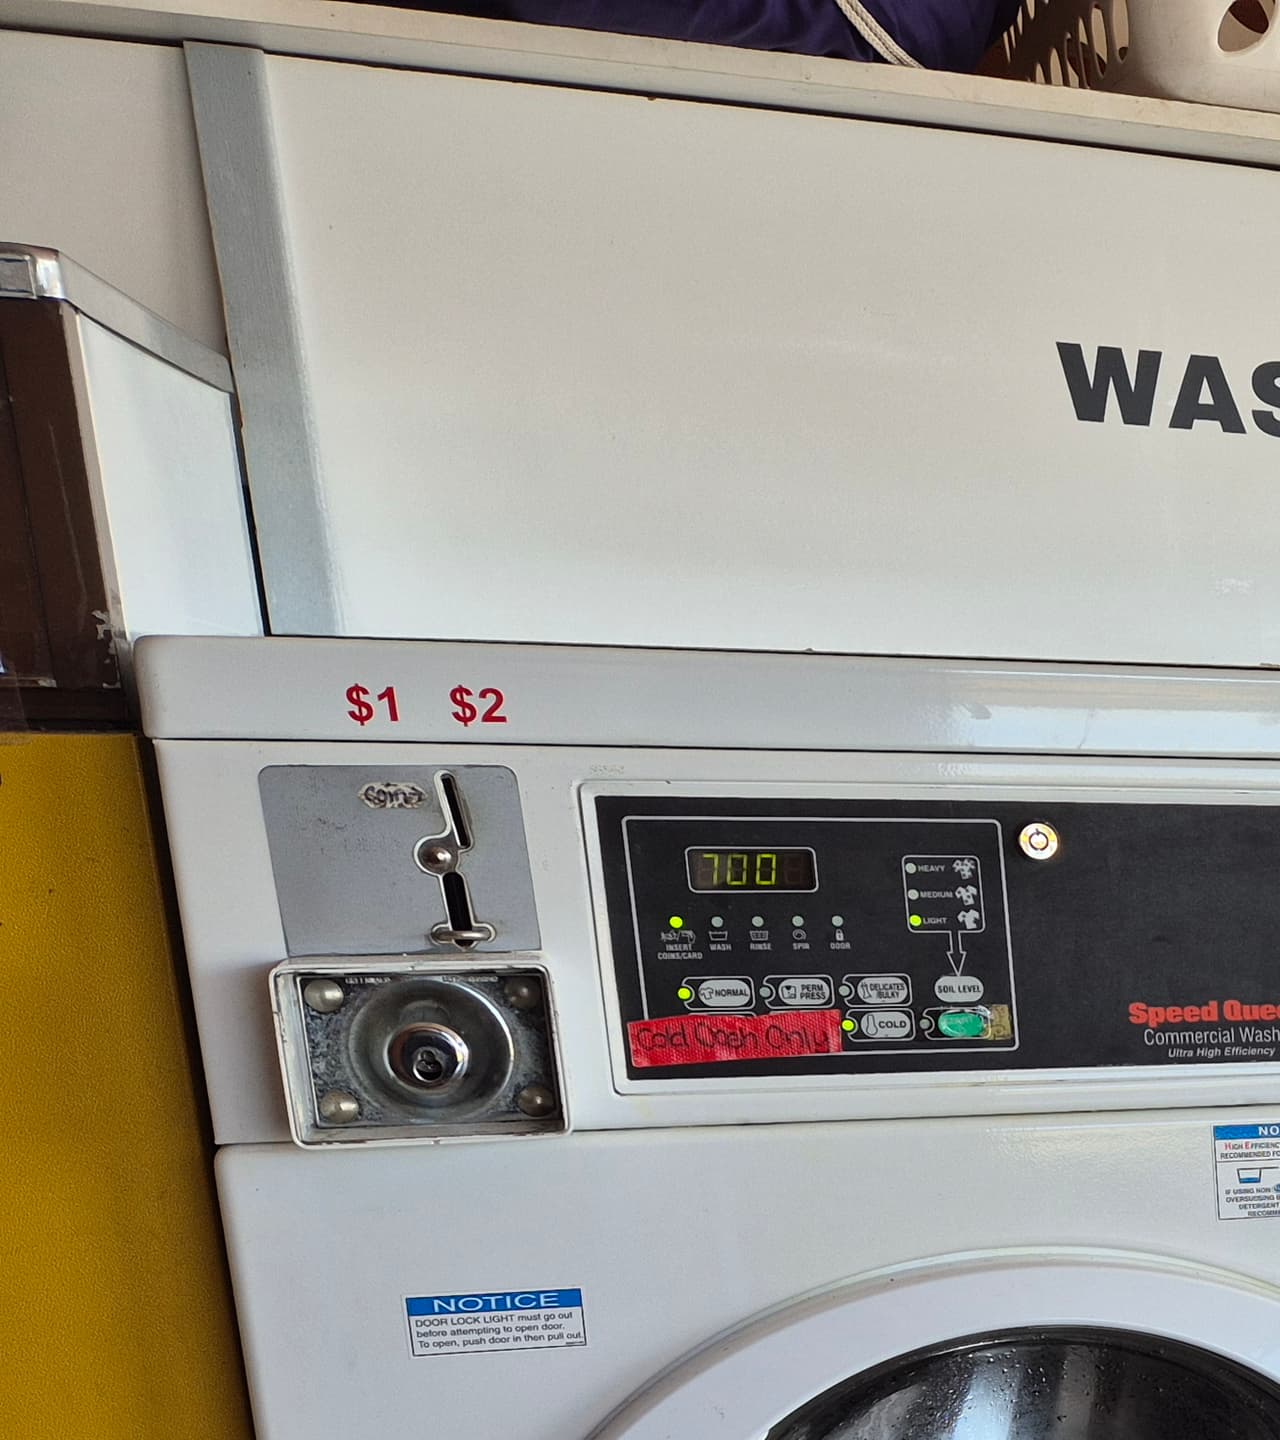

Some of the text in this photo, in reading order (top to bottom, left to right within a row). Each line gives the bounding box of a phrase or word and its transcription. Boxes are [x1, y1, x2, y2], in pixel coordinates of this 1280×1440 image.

[346, 684, 507, 726] $1 $2
[703, 854, 776, 885] 700
[715, 989, 749, 997] NORMAL
[801, 984, 823, 992] PERM
[869, 983, 905, 991] DELICATES
[938, 985, 955, 993] SOIL
[801, 992, 826, 1000] PRESS
[1129, 1000, 1218, 1027] Speed
[1144, 1027, 1234, 1045] Commercial
[1168, 1047, 1276, 1058] Ultra High Efficiency
[1220, 1151, 1271, 1159] RECOMMENDED
[433, 1293, 560, 1313] NOTICE
[415, 1312, 573, 1328] DOOR LOCK LIGHT must go out
[416, 1322, 565, 1338] before attempting to open door.
[418, 1331, 584, 1349] To open, push door in then pull out.
